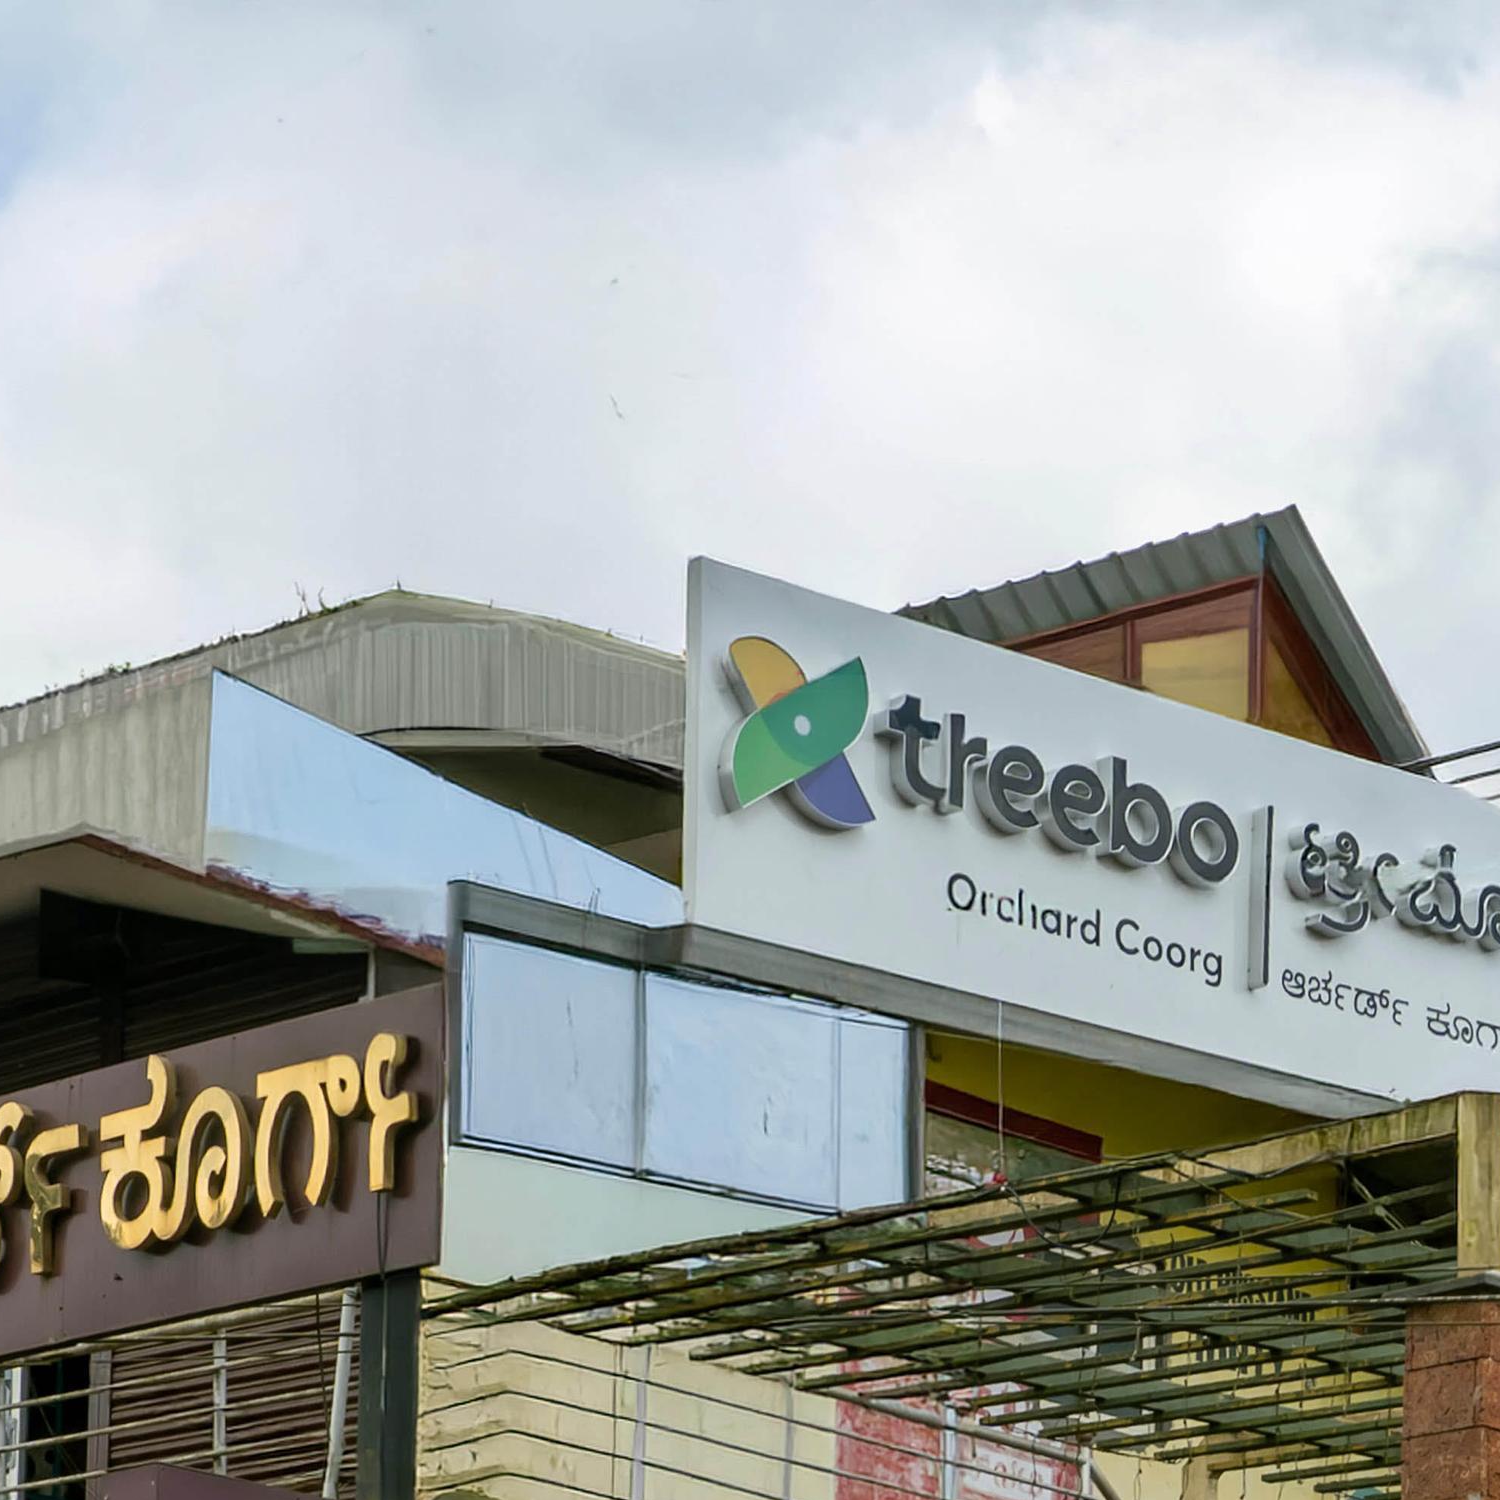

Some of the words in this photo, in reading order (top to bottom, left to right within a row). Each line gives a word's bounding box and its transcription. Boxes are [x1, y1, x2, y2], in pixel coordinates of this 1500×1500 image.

[875, 694, 1238, 886] treebo
[946, 872, 1102, 947] Orchard
[1115, 917, 1224, 988] Coorg
